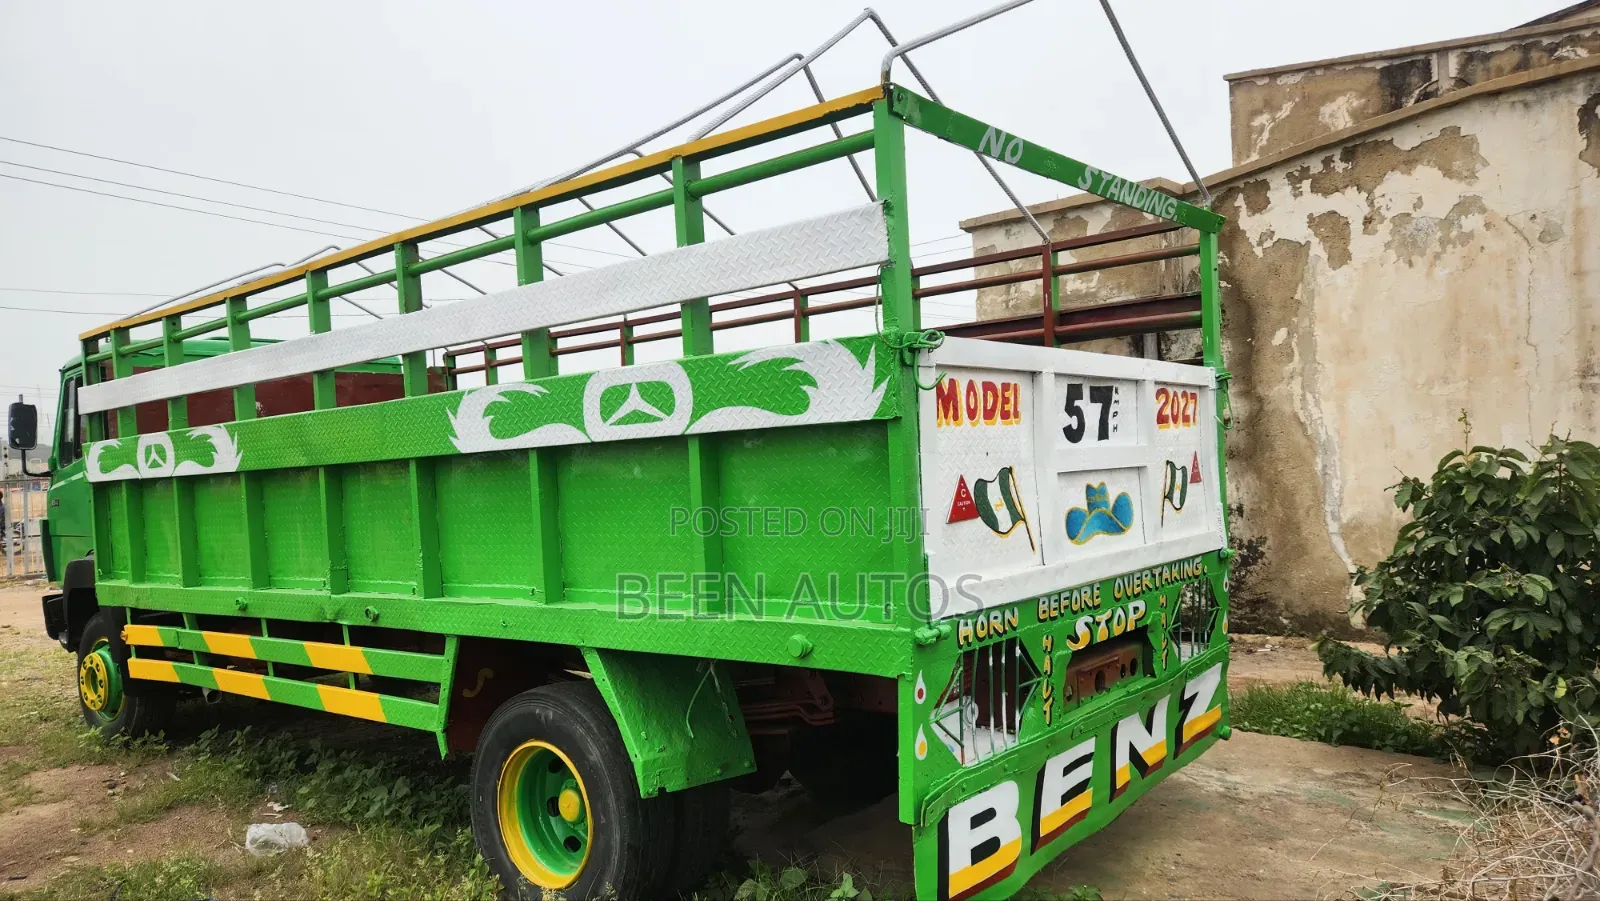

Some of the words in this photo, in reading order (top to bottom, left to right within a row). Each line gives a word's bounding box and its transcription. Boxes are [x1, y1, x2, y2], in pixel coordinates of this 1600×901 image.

[977, 126, 1024, 164] NO
[1062, 383, 1114, 444] 57
[1155, 387, 1198, 429] 2027
[956, 606, 1020, 647] HORN
[1037, 583, 1102, 623] BEFORE
[1066, 599, 1147, 651] STOP
[938, 661, 1224, 900] BENZ
